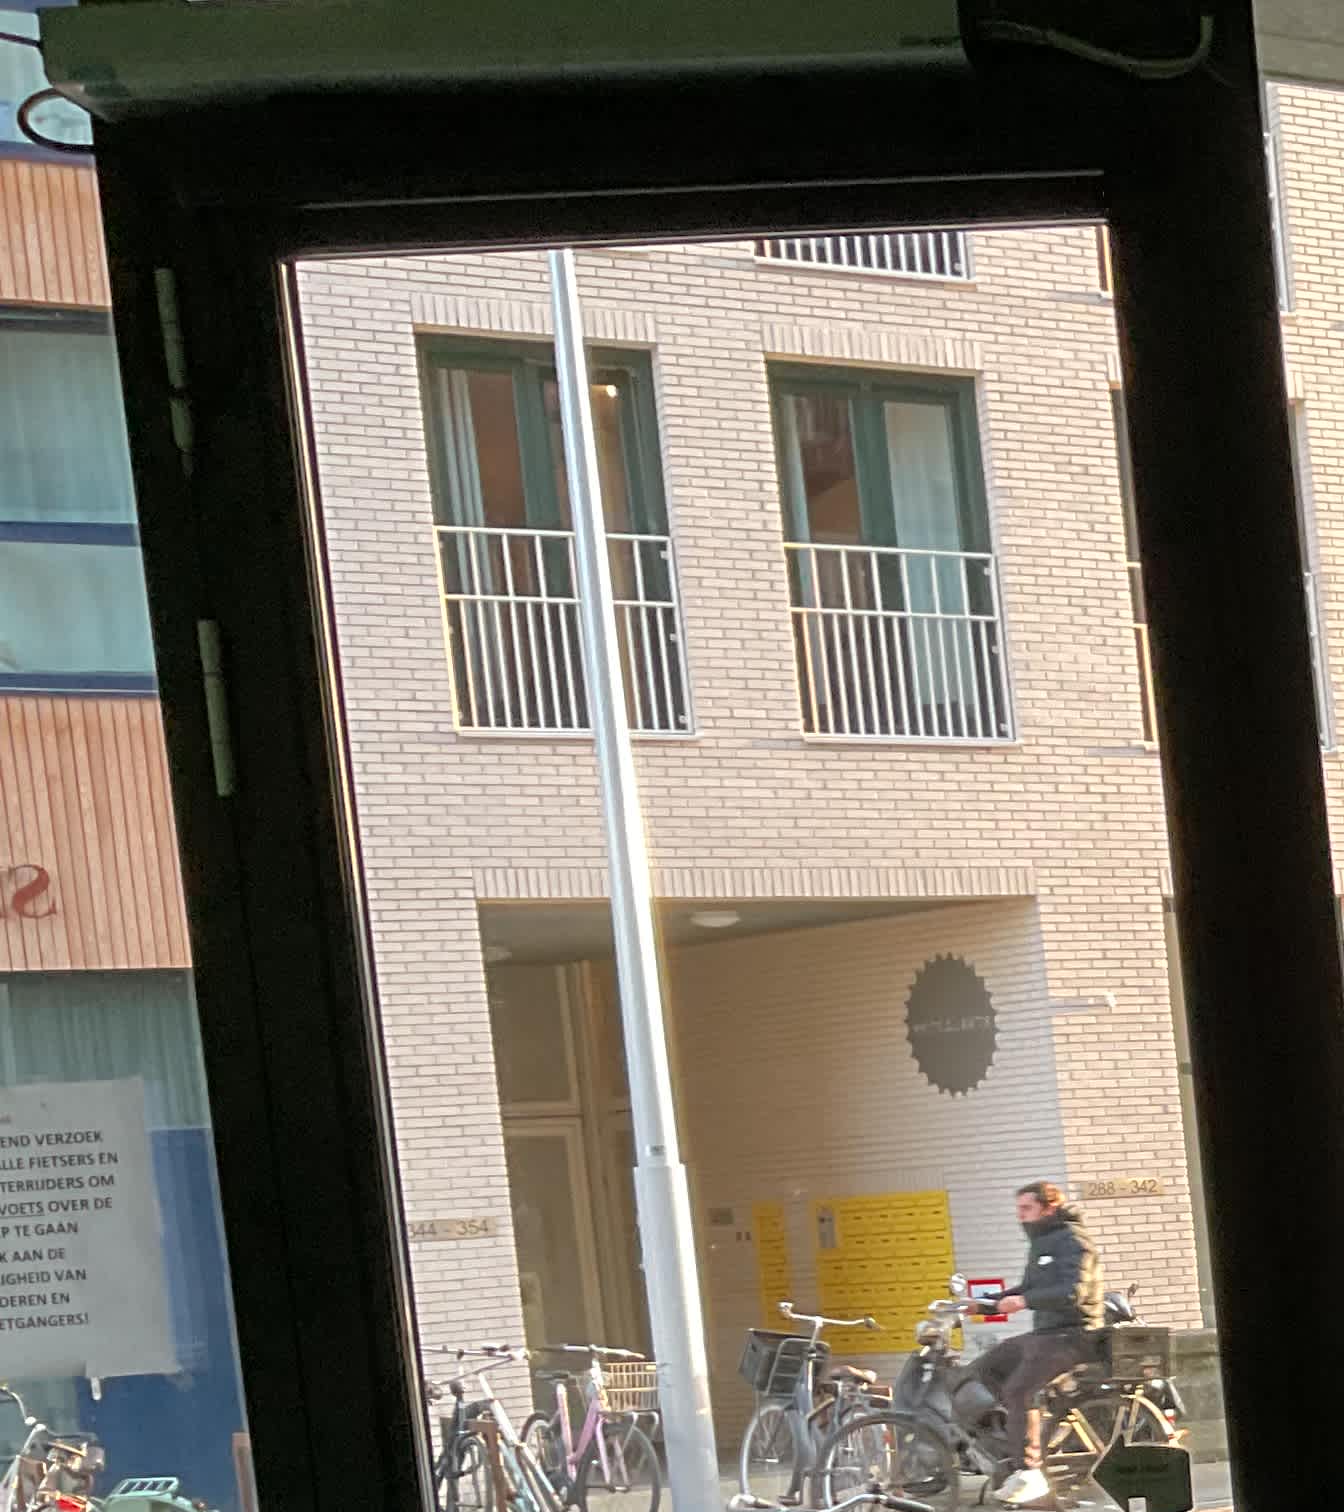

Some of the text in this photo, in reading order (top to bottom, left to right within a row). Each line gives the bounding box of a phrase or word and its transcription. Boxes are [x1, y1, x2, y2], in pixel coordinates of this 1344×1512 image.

[34, 1130, 104, 1146] VERZOEK
[0, 1151, 119, 1170] LLE FIETSERS EN
[88, 1173, 115, 1188] OM
[1087, 1181, 1116, 1196] 288
[1130, 1179, 1158, 1194] 342
[0, 1196, 113, 1217] VOETS OVER DE
[14, 1224, 32, 1238] TE
[34, 1221, 79, 1237] GAAN
[456, 1219, 490, 1236] 354
[12, 1249, 43, 1263] AAN
[47, 1247, 66, 1261] DE
[54, 1268, 87, 1282] VAN
[51, 1292, 71, 1305] EN
